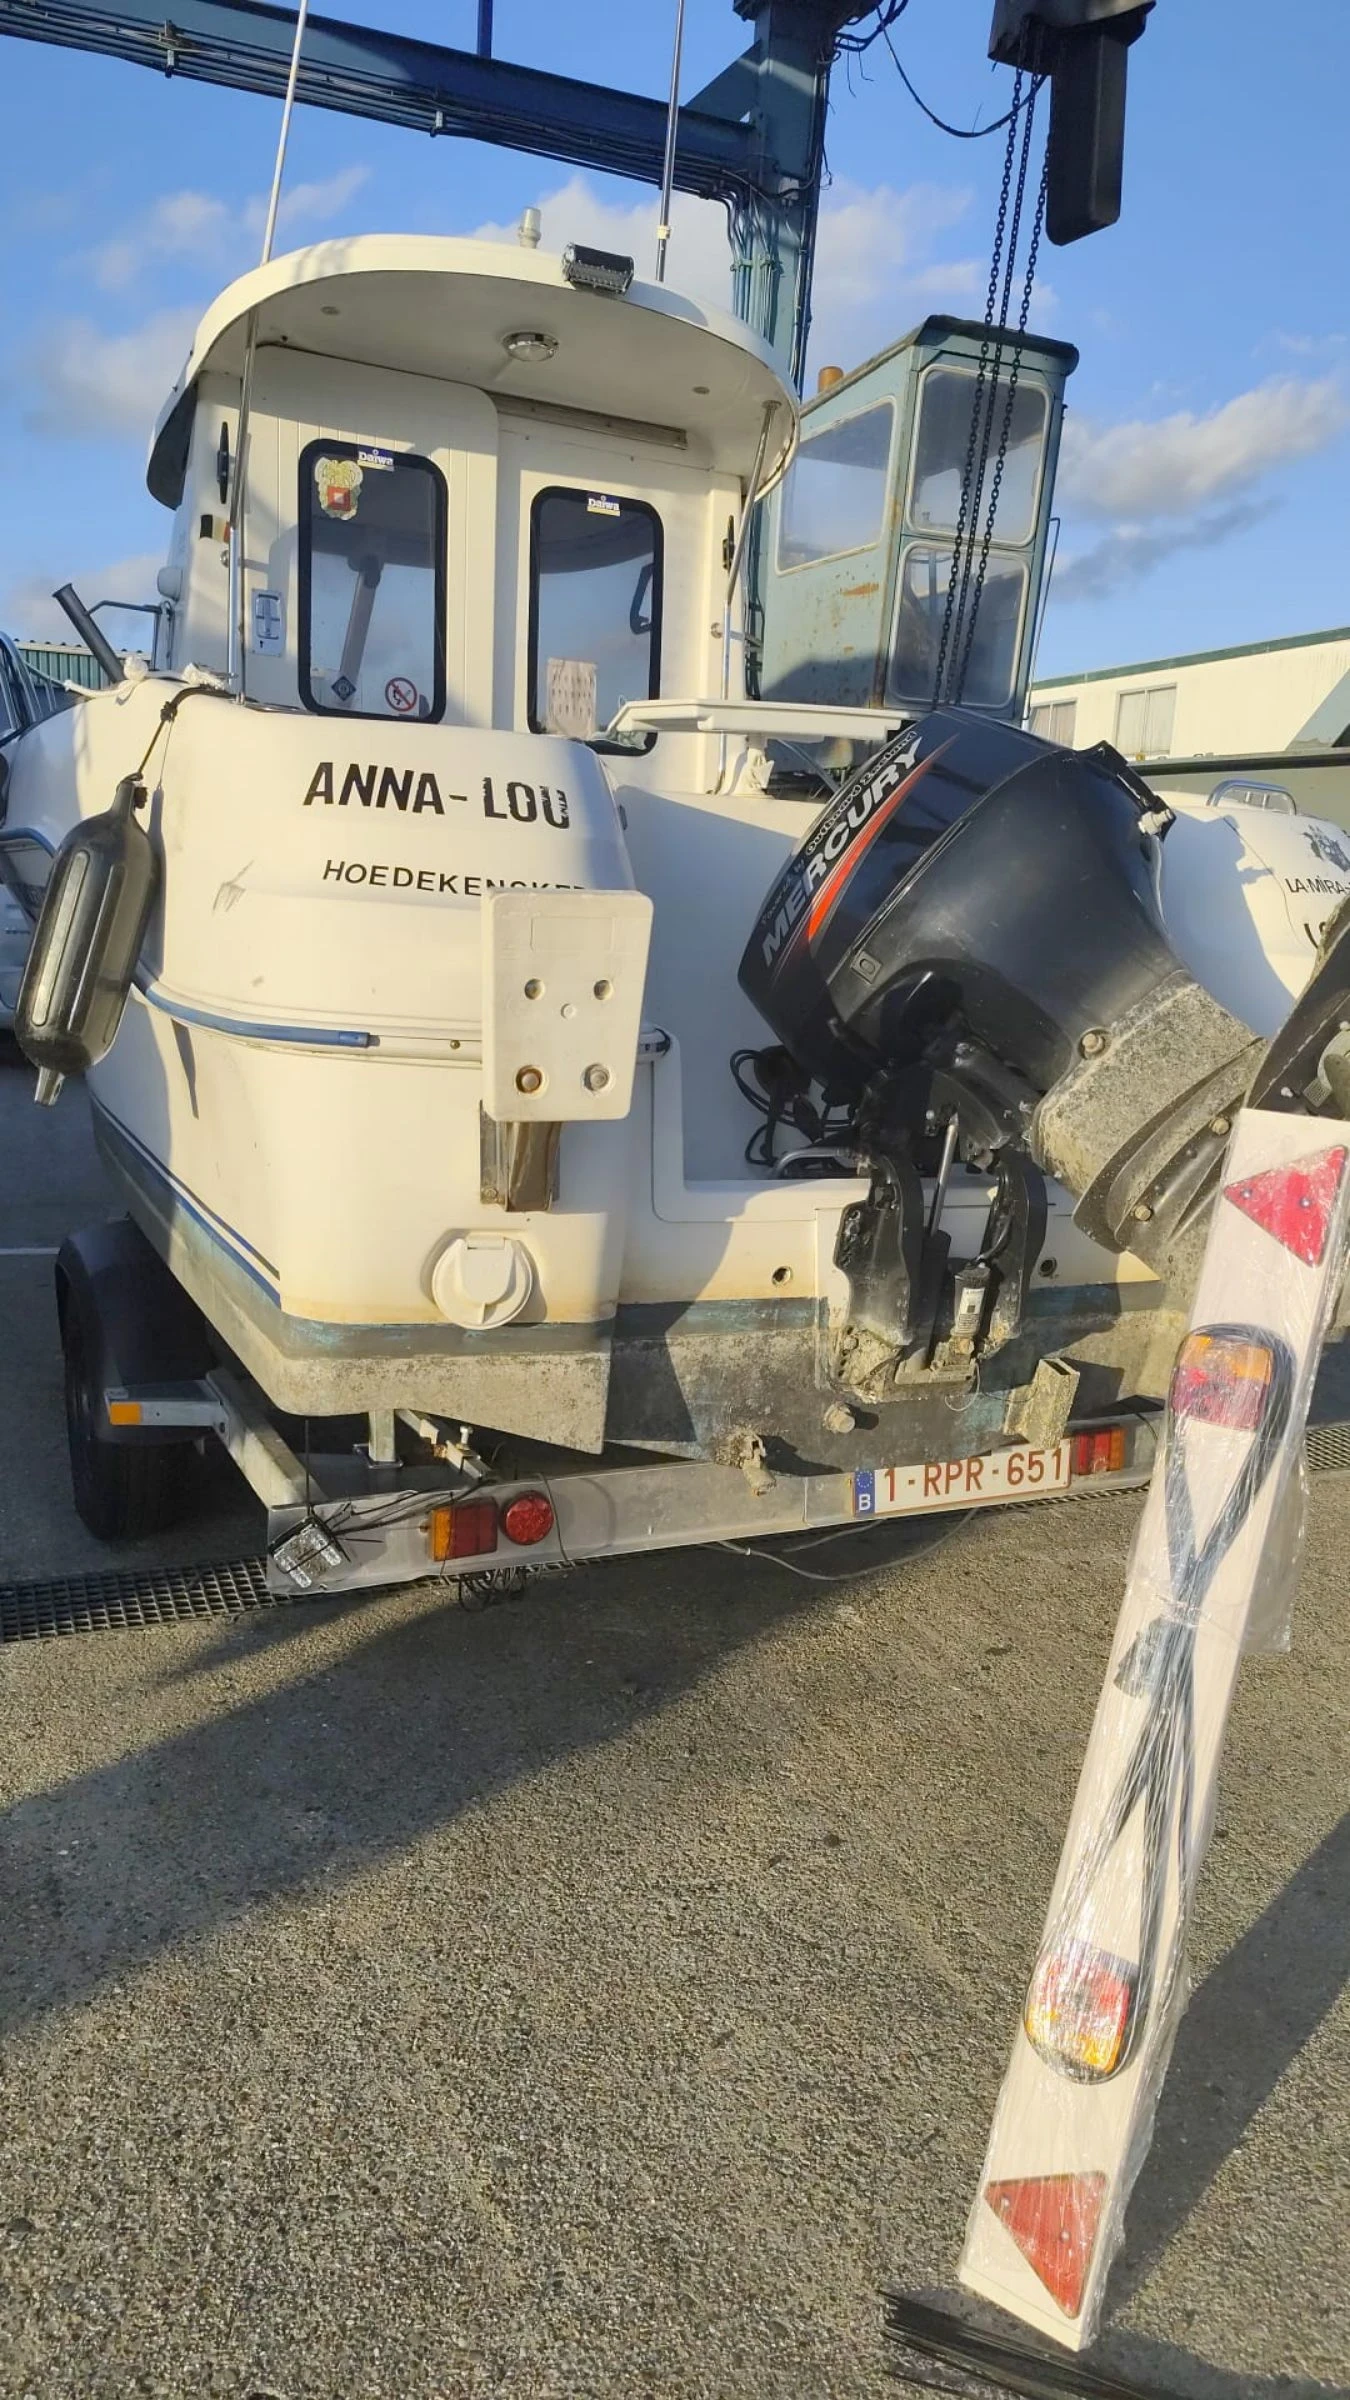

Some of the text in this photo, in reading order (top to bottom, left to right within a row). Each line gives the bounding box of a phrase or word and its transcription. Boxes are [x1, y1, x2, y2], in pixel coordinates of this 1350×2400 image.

[358, 450, 394, 466] Daiwa
[762, 737, 922, 967] MERCURY
[323, 860, 584, 897] HOEDEKE
[884, 1448, 1062, 1502] 1-RPR-651
[858, 1493, 871, 1511] B
